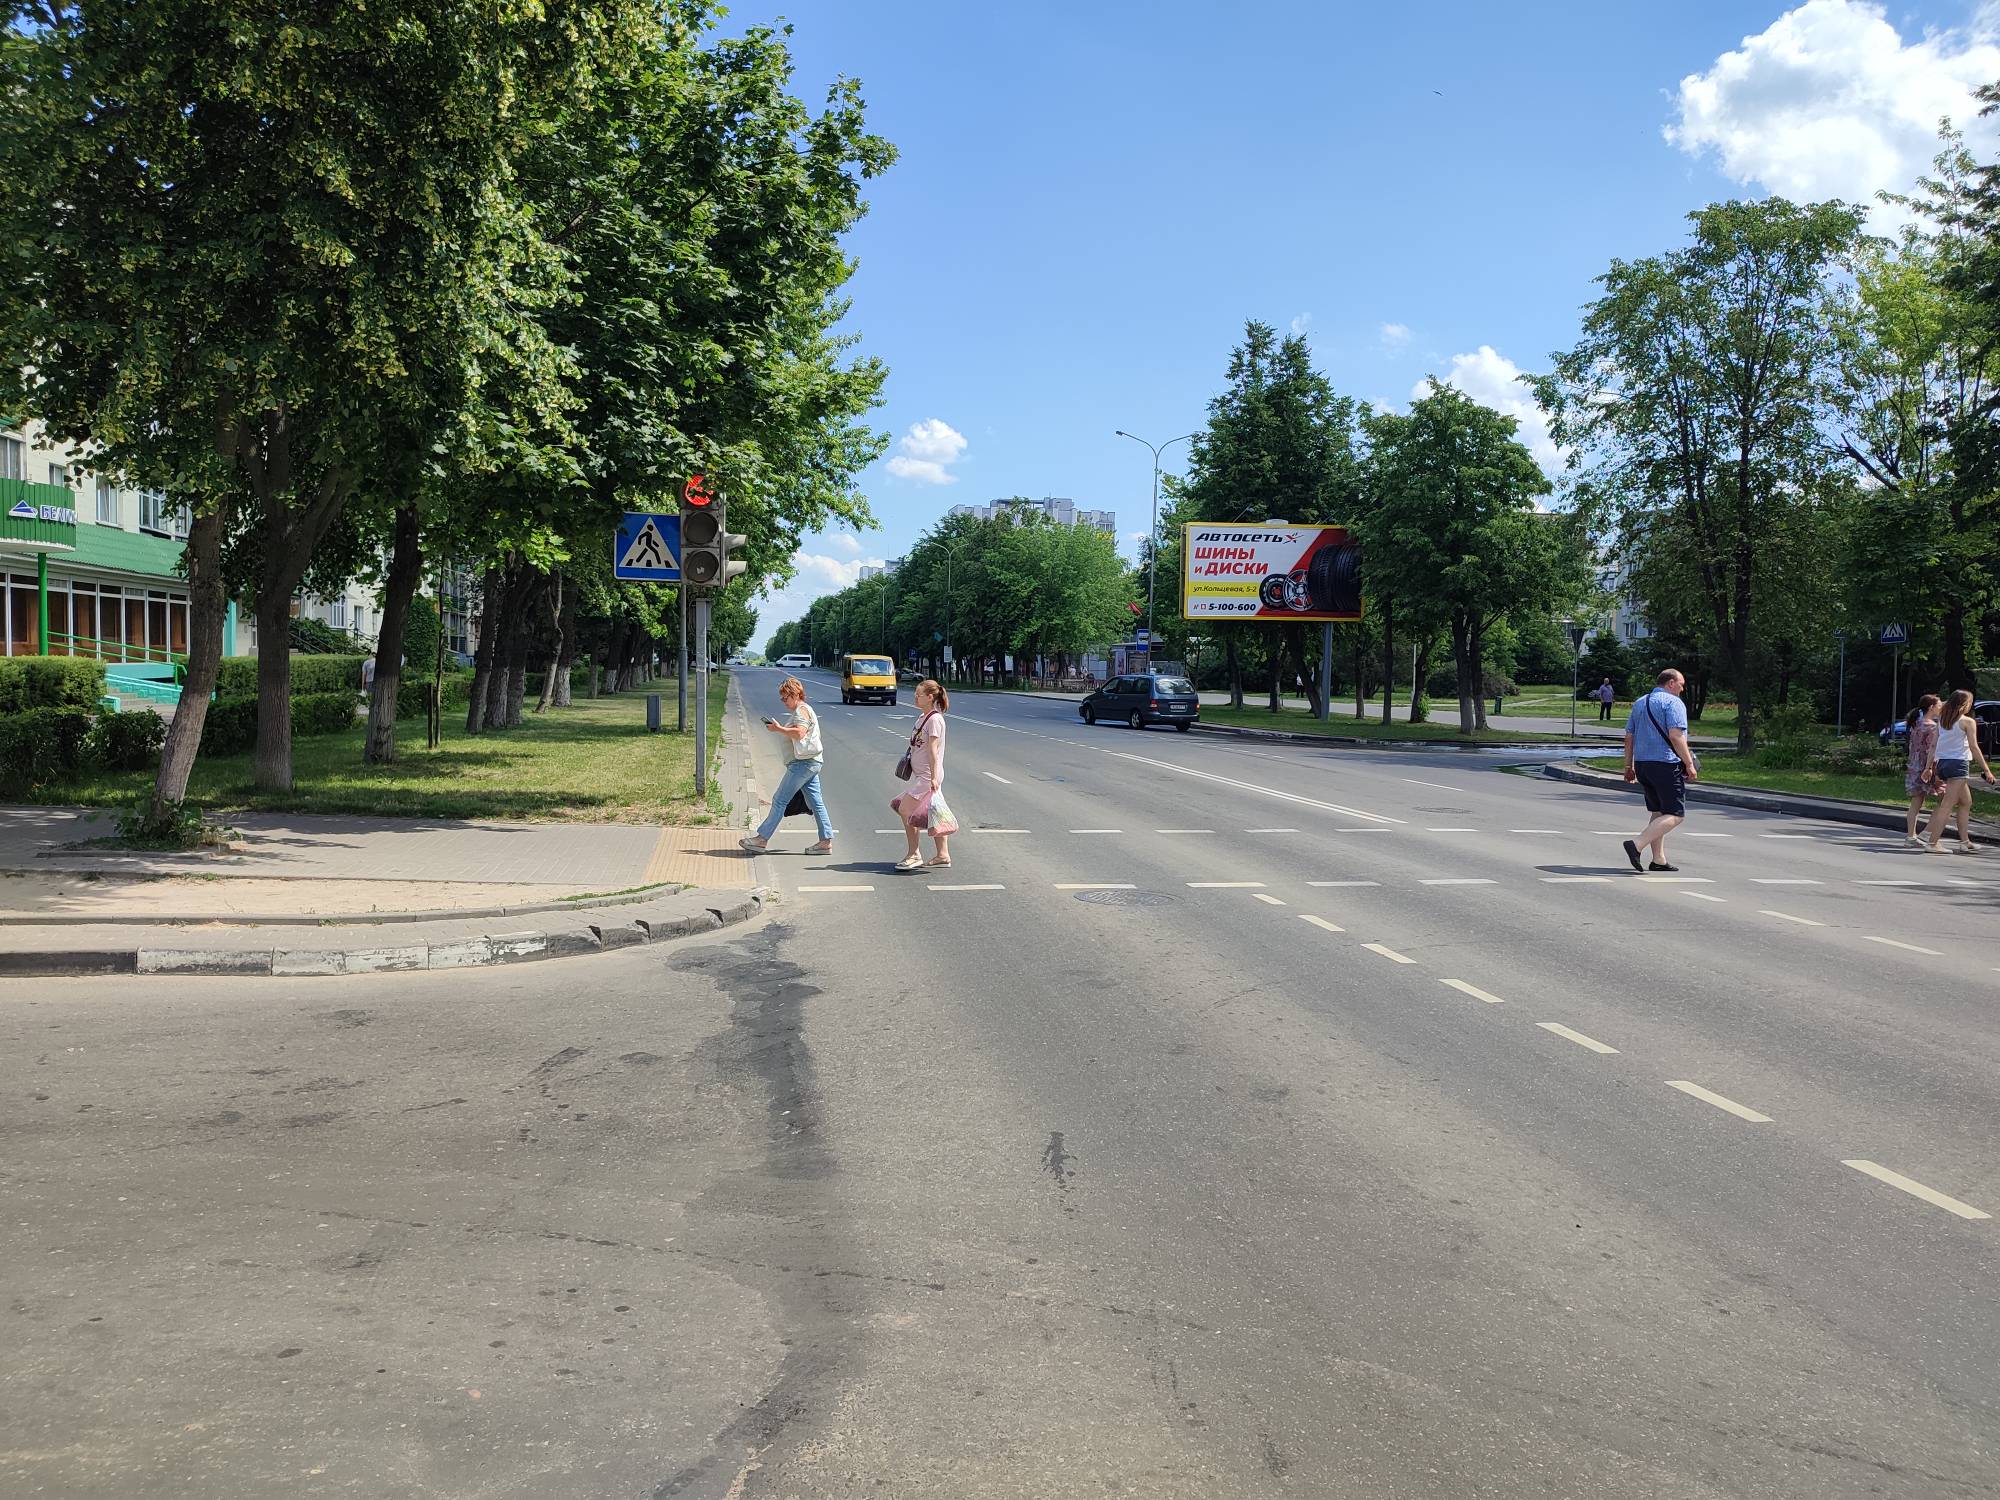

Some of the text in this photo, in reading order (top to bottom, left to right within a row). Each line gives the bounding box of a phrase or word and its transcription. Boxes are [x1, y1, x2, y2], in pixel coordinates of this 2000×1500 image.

[1195, 547, 1255, 559] ШИНЫ
[1204, 562, 1269, 576] ДИСКИ
[1208, 603, 1257, 611] 5-100-600
